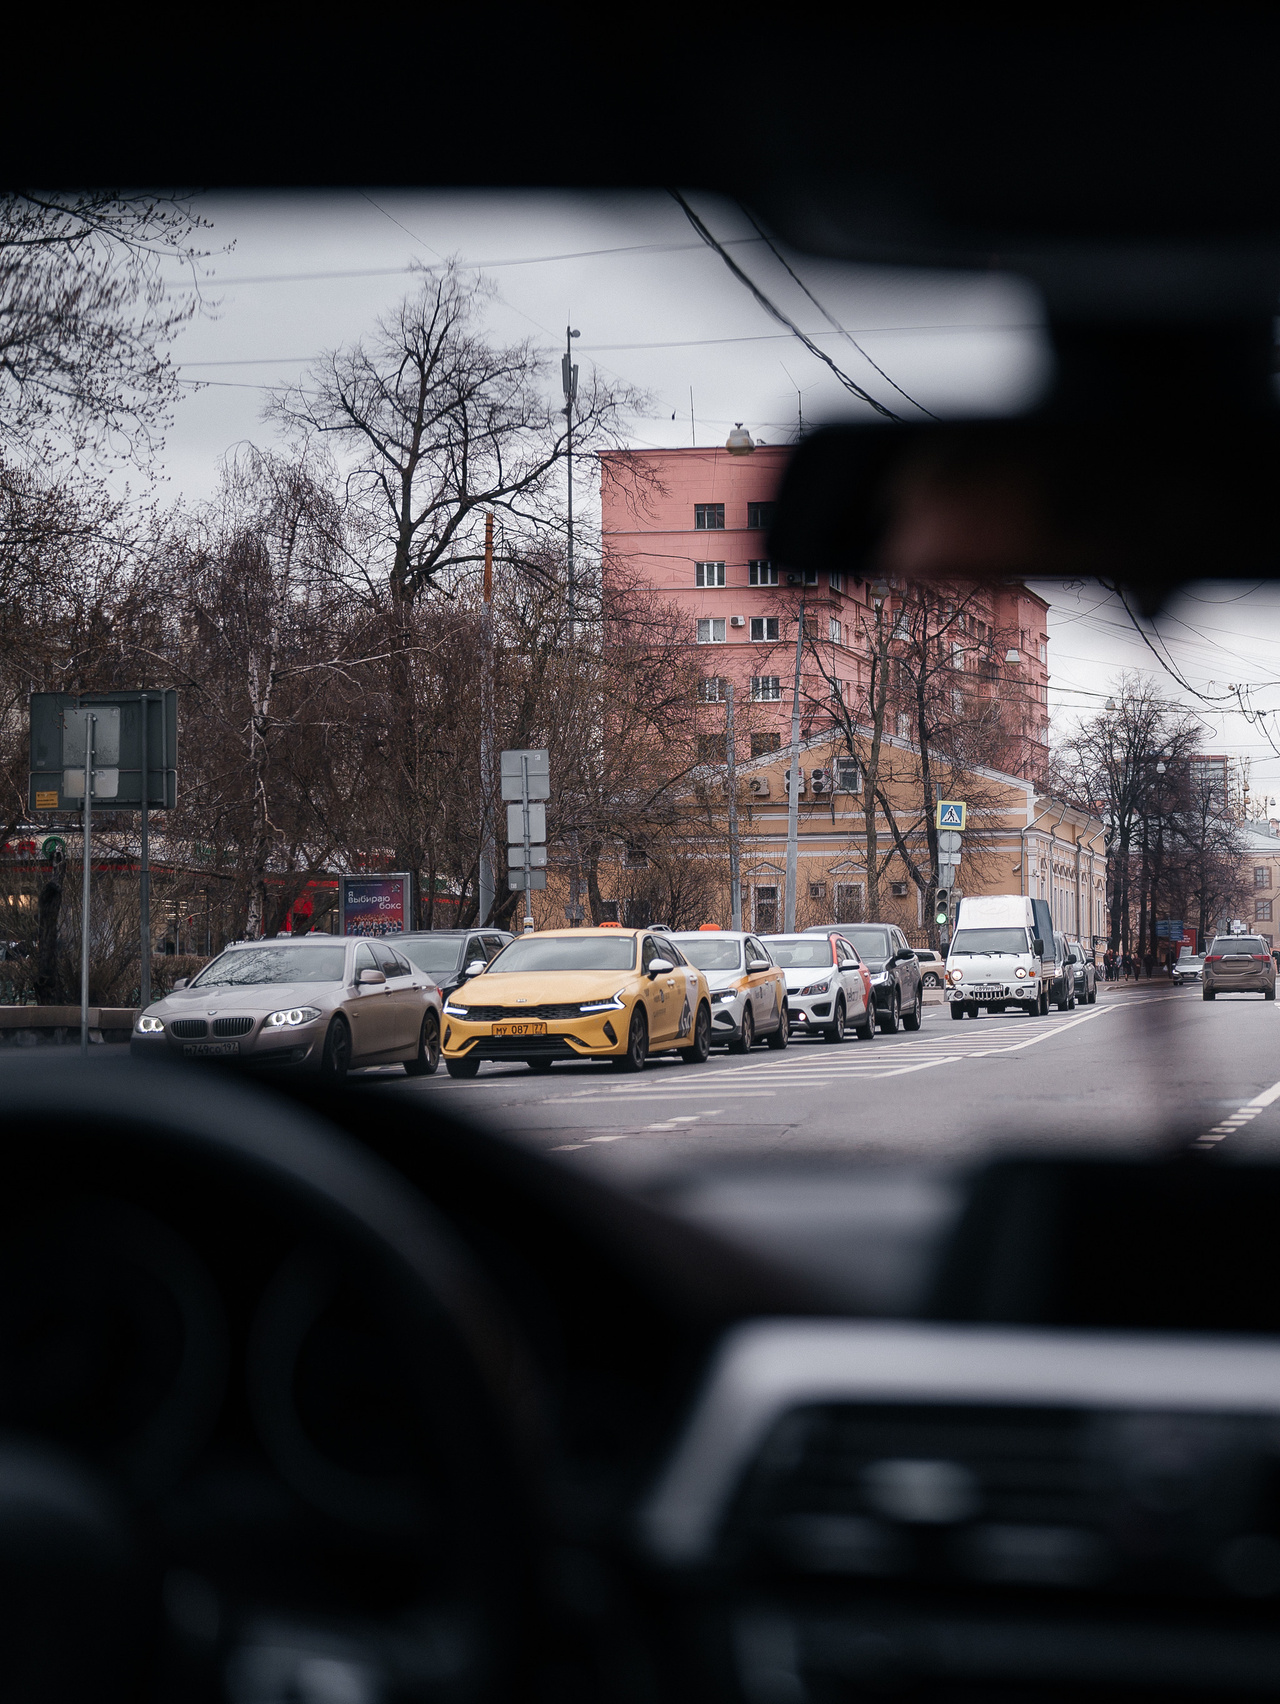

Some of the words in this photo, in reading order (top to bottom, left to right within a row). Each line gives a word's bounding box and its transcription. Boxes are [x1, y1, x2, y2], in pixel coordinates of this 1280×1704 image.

[348, 895, 390, 904] выбираю
[379, 902, 402, 910] бокс
[511, 1025, 529, 1035] 087
